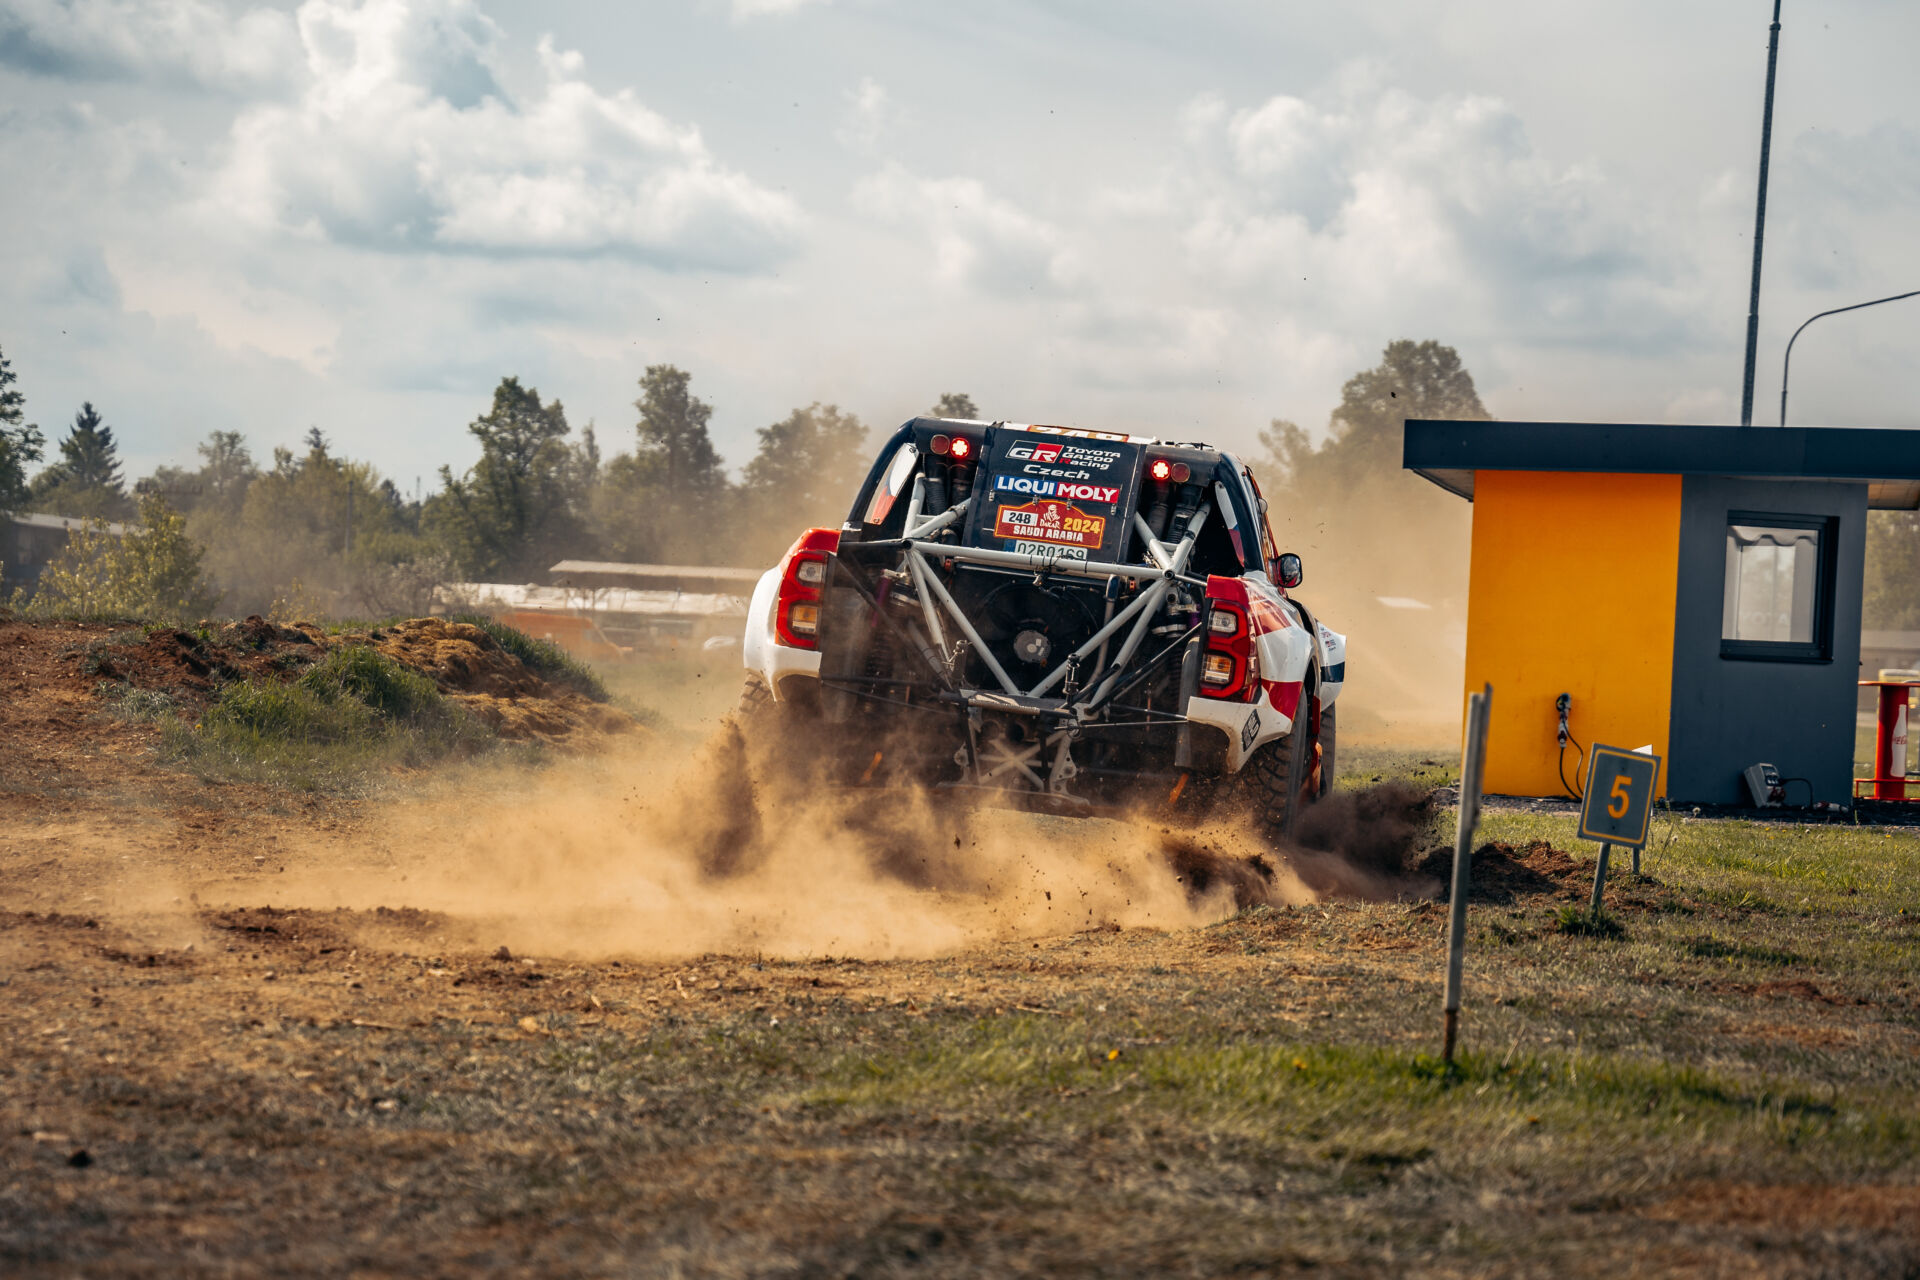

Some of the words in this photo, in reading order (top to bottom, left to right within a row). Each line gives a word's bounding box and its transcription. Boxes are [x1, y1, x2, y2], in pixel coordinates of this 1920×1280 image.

[1009, 448, 1057, 463] GR
[1062, 452, 1114, 463] GAZOO
[1066, 446, 1121, 458] TOYOTA
[1058, 458, 1110, 470] Racing
[1023, 464, 1090, 480] Czech
[997, 476, 1055, 495] LIQUI
[1057, 483, 1118, 502] MOLY
[1008, 512, 1031, 525] 248
[1063, 517, 1101, 534] 2024
[1013, 525, 1044, 538] SAUDI
[1045, 529, 1083, 543] ARABIA
[1607, 774, 1633, 819] 5
